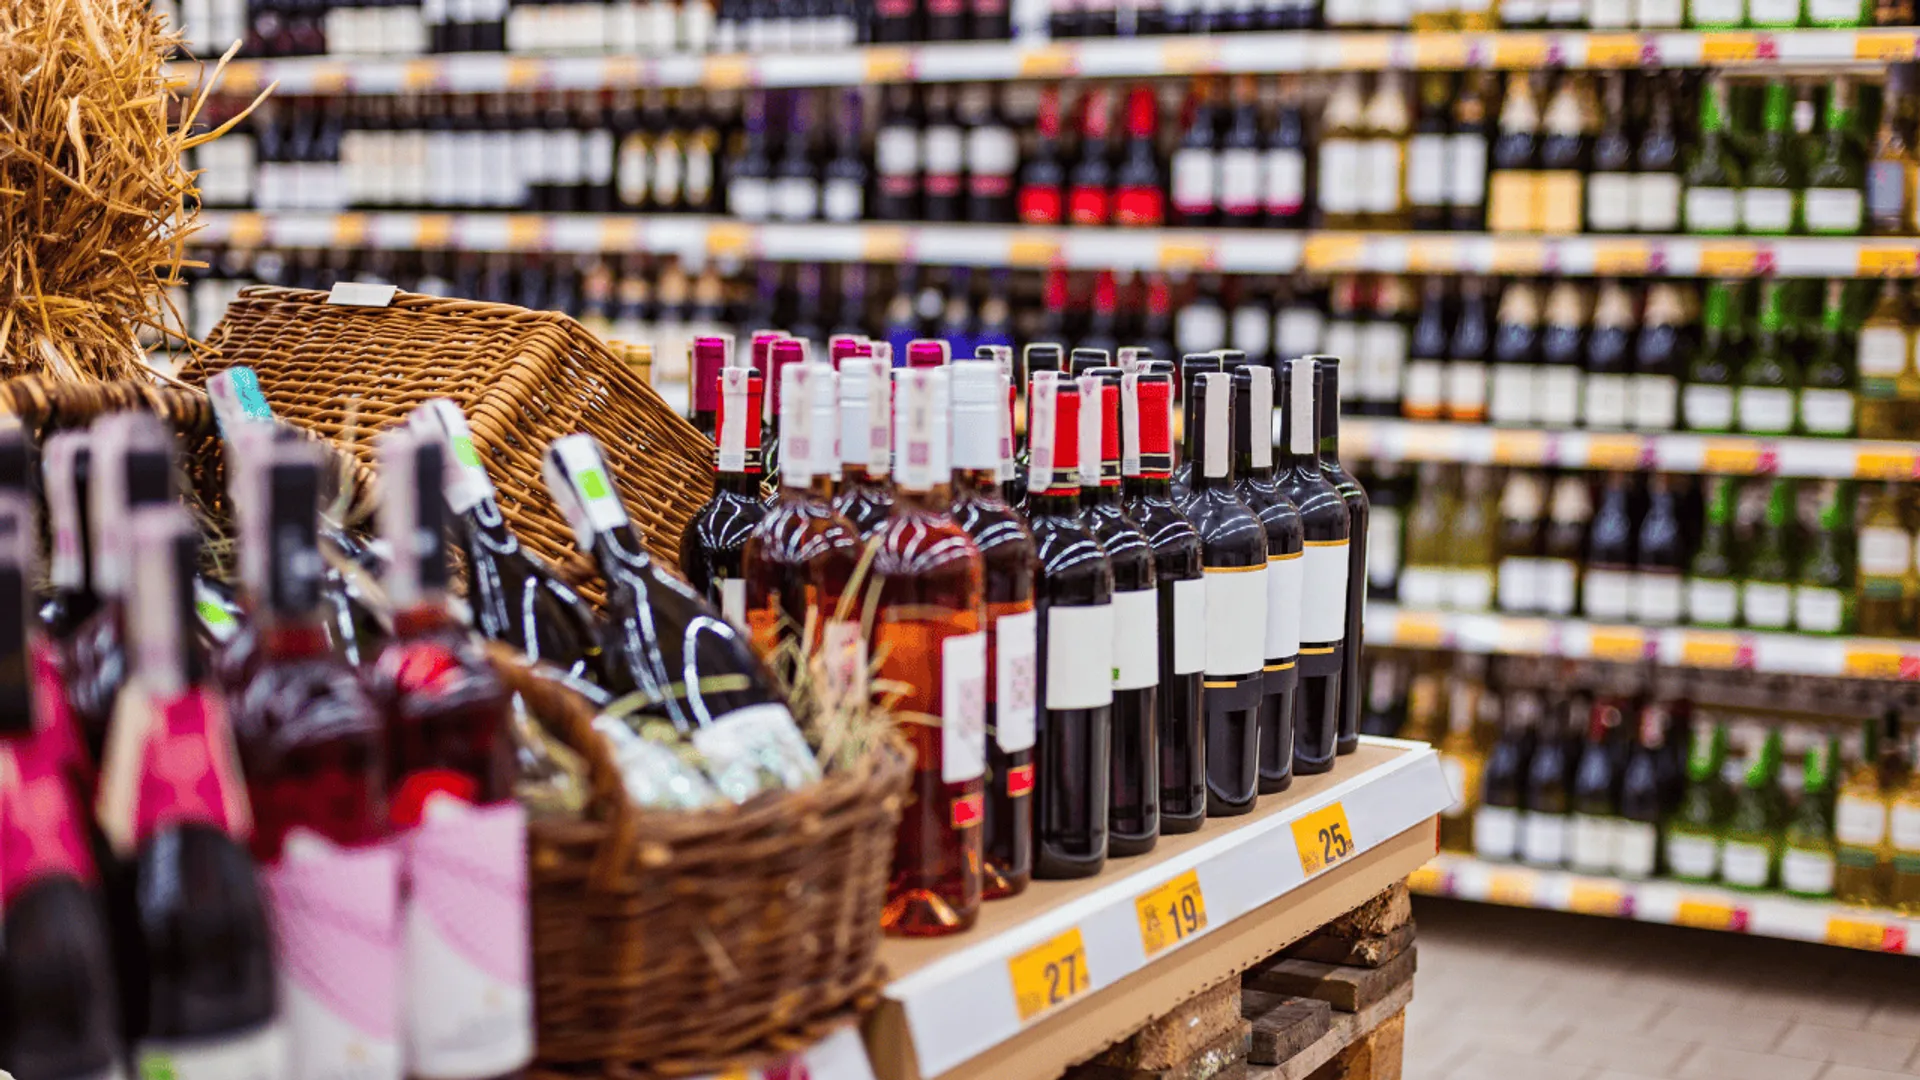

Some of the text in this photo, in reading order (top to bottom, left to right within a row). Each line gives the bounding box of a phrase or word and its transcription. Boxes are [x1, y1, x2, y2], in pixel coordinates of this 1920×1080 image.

[1319, 822, 1347, 864] 25
[1168, 894, 1197, 940] 19
[1043, 953, 1076, 1004] 27
